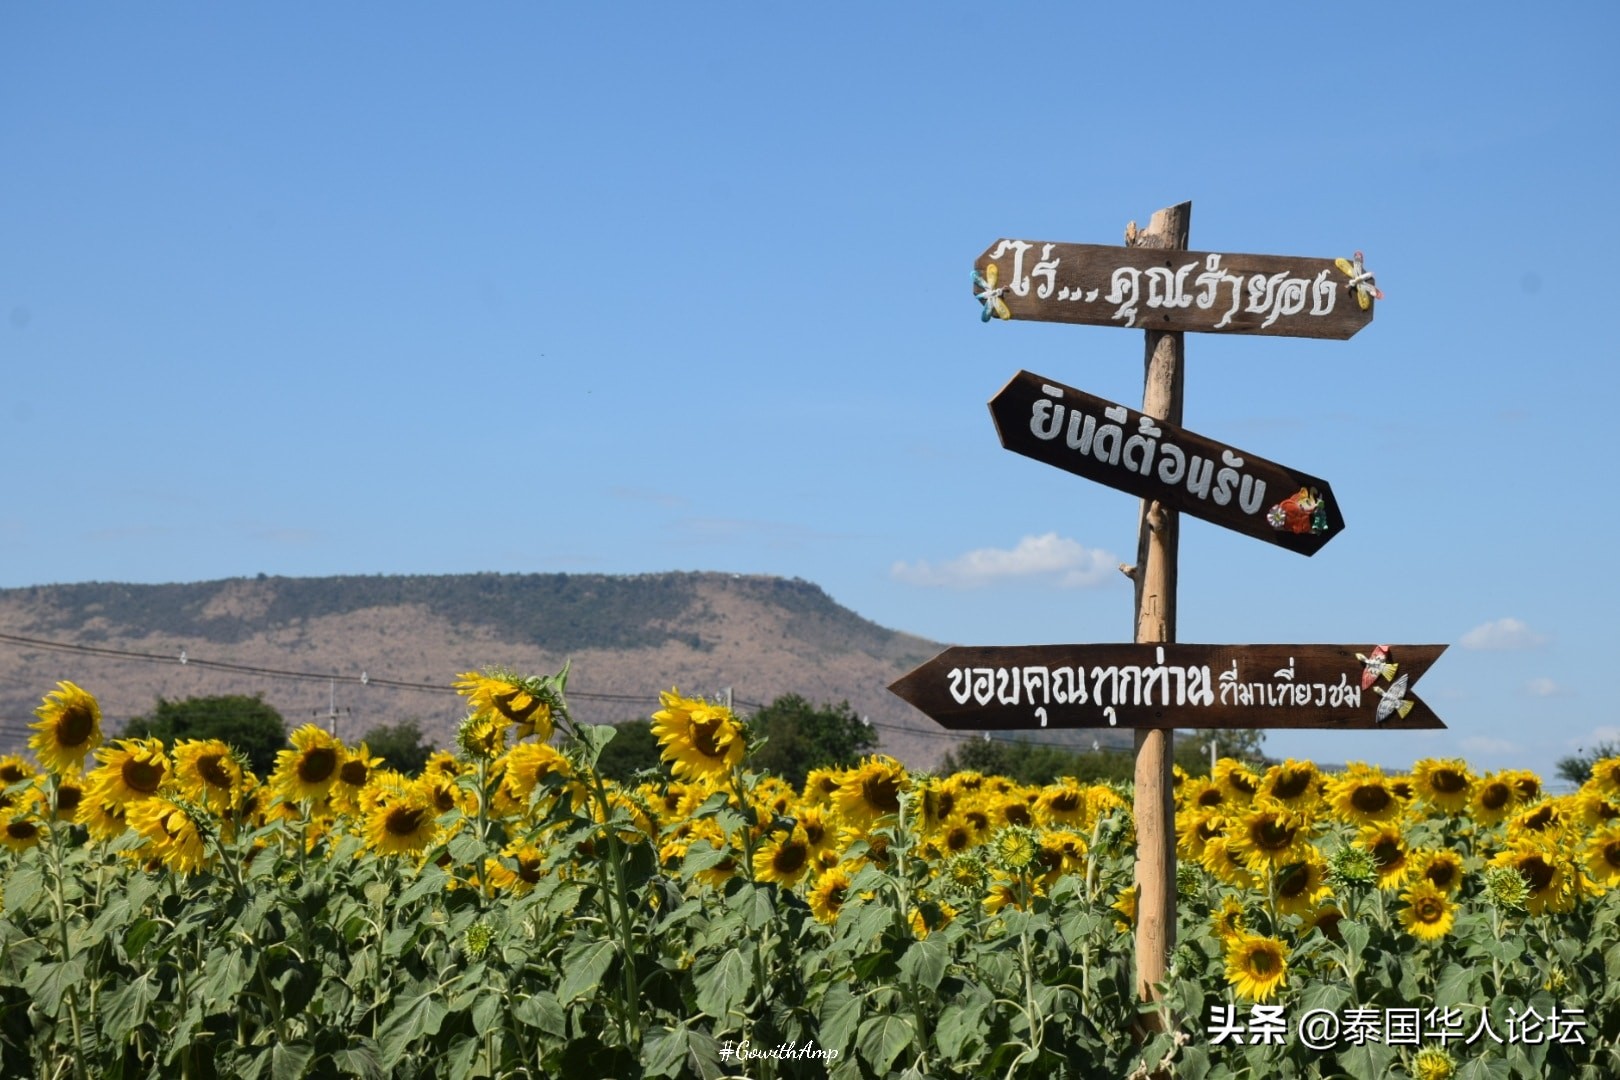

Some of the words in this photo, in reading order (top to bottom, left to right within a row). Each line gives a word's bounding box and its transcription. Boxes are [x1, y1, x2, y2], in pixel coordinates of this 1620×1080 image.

[1029, 384, 1267, 515] ยินดีต้อนรับ
